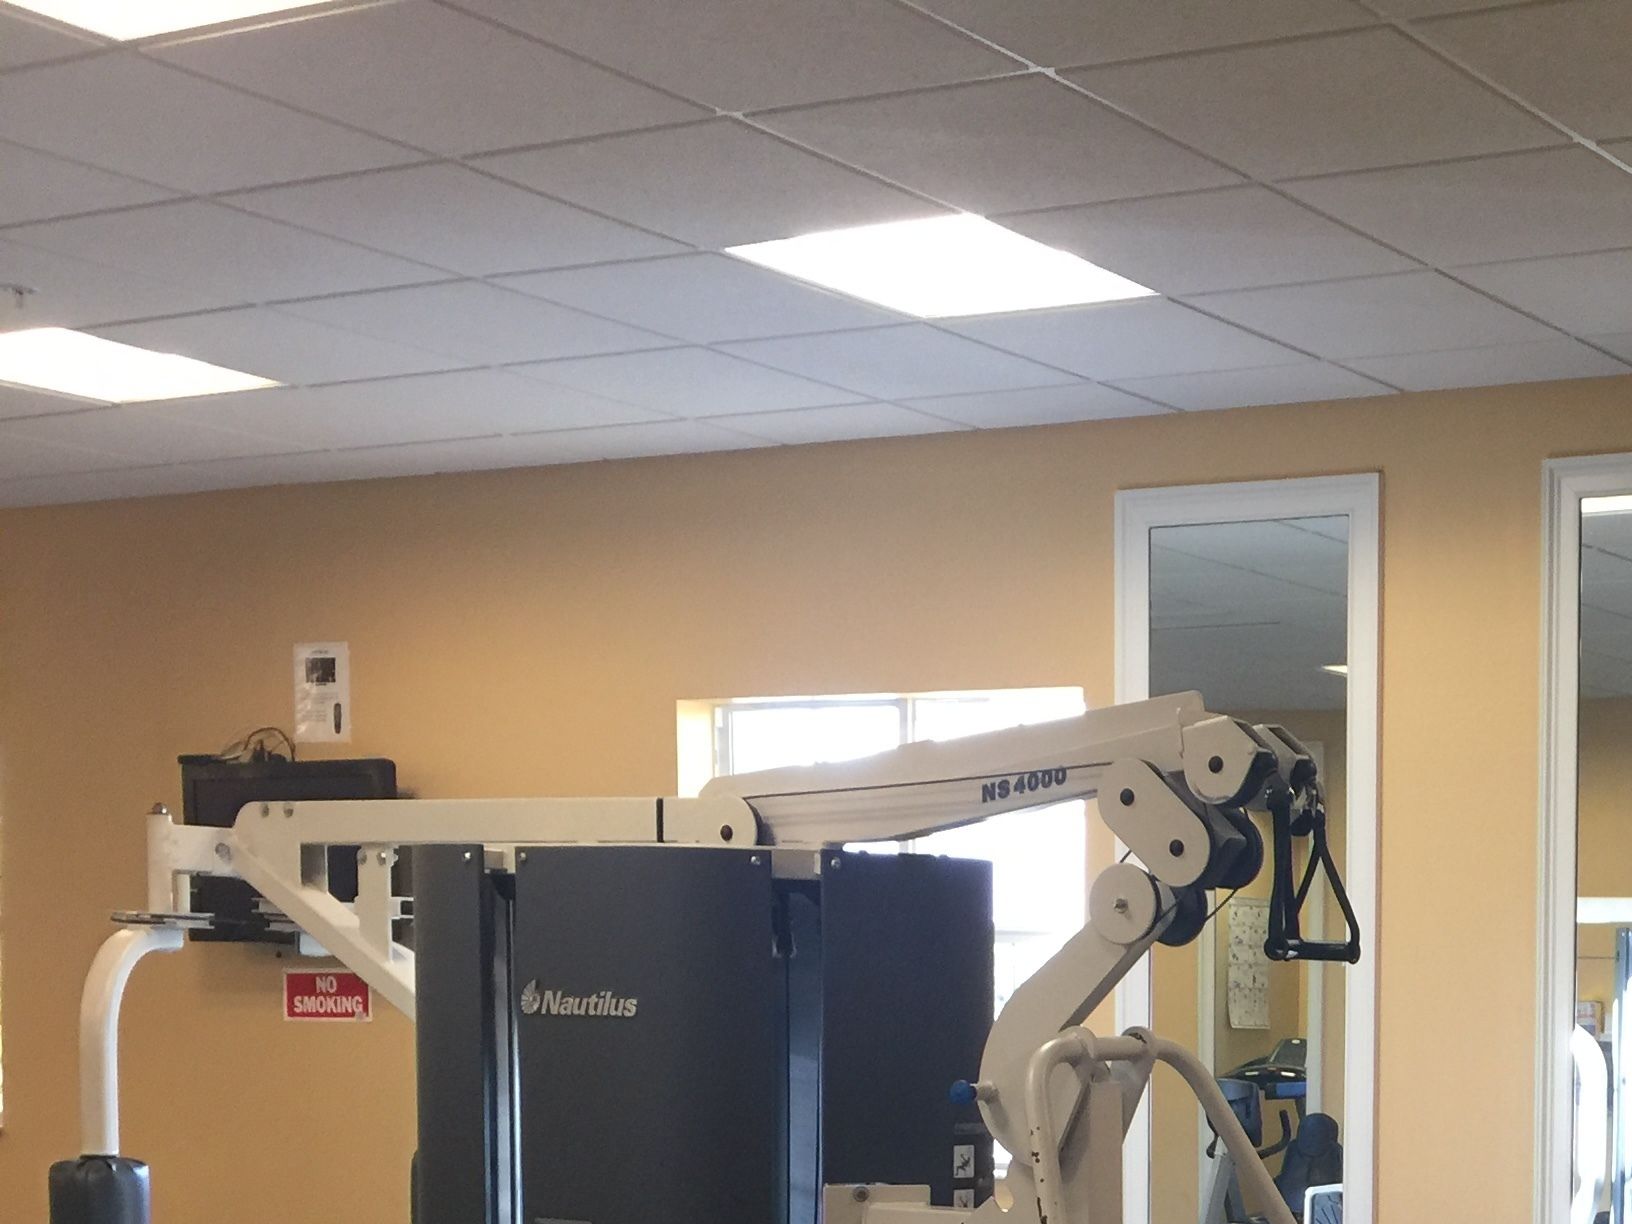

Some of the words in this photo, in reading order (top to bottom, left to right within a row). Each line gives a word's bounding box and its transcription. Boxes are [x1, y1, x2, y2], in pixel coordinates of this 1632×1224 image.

[982, 779, 1010, 803] NS
[1013, 767, 1067, 794] 4000
[315, 976, 337, 994] NO
[293, 996, 364, 1013] SMOKING
[541, 990, 638, 1017] Nautilus
